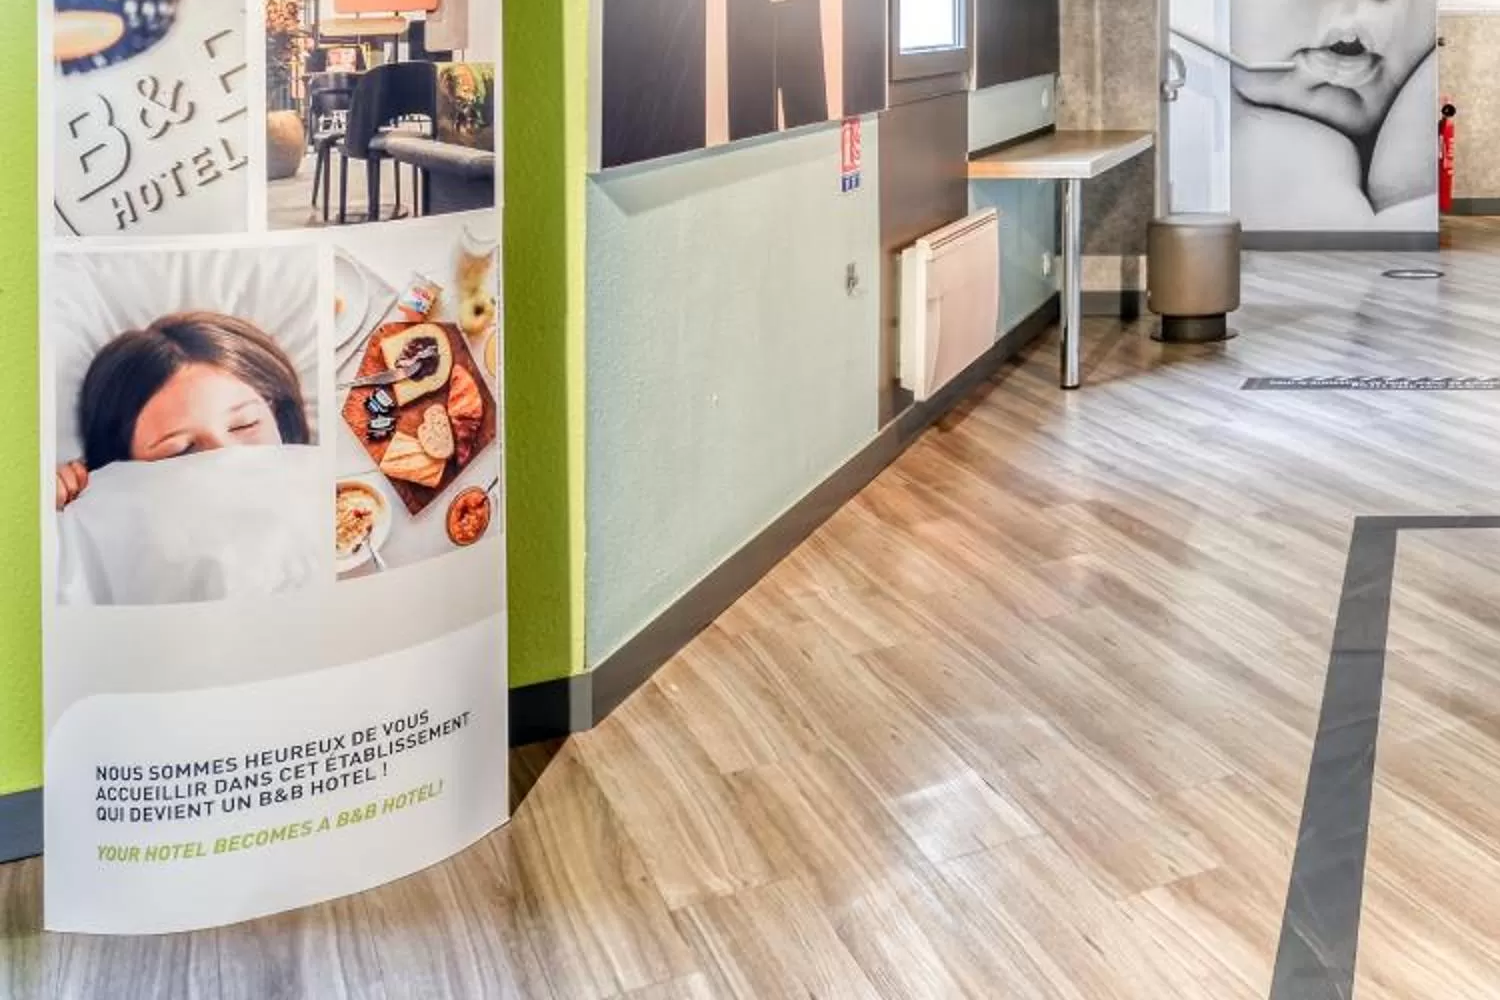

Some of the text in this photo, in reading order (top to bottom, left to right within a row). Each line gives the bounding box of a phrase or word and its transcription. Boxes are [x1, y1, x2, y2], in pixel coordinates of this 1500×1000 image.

[96, 710, 429, 782] NOUS SOMMES HEUREUX DE VOUS
[96, 711, 471, 802] ACCUEILLIR DANS CET ÉTABLISSEMENT
[96, 807, 124, 823] QUI
[129, 800, 214, 823] DEVIENT
[221, 797, 251, 814] UN
[259, 785, 304, 808] B&B
[311, 769, 376, 797] HOTEL
[96, 845, 140, 862] YOUR
[145, 844, 207, 863] HOTEL
[213, 822, 312, 855] BECOMES
[316, 817, 331, 833] A
[336, 803, 378, 828] B&B
